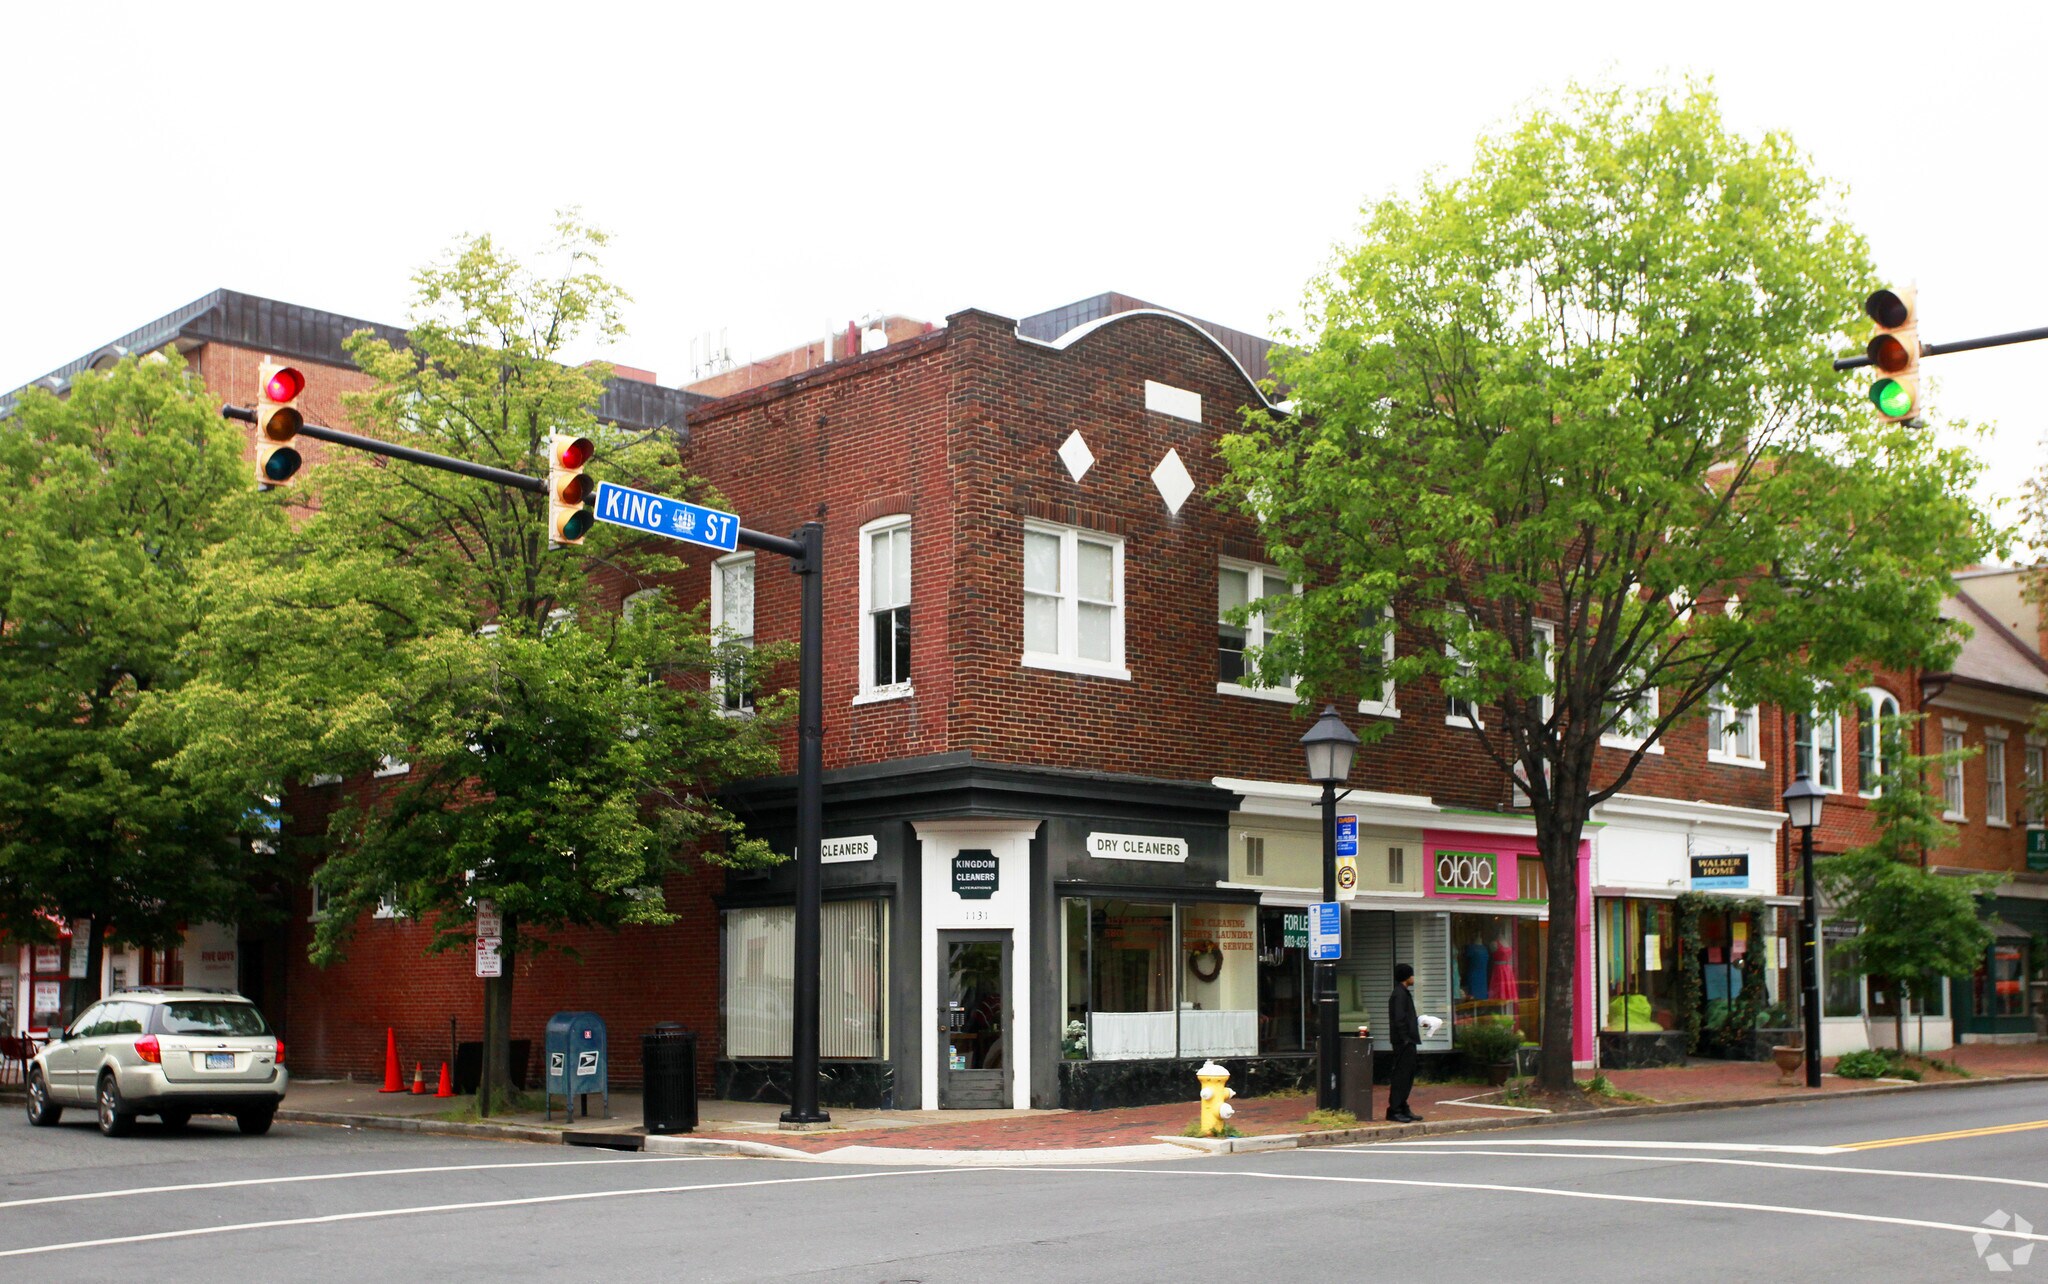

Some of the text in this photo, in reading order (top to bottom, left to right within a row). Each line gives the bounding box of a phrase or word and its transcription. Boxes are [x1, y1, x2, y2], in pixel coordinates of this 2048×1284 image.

[606, 489, 731, 544] KING ST
[822, 842, 869, 857] CLEANERS
[1097, 839, 1180, 856] DRY CLEANERS
[956, 860, 995, 868] KINGDOM
[1698, 858, 1741, 867] WALKER
[1703, 867, 1736, 875] HOME
[956, 873, 995, 881] CLEANERS
[966, 911, 988, 920] 1131
[1208, 919, 1245, 928] CLEANING
[1283, 914, 1299, 930] FOR
[1299, 915, 1308, 931] LE
[1215, 930, 1254, 939] LAUNDRY
[1222, 942, 1254, 950] SERVICE
[1283, 935, 1308, 948] 803-435-
[202, 951, 235, 961] FIVE GUYS
